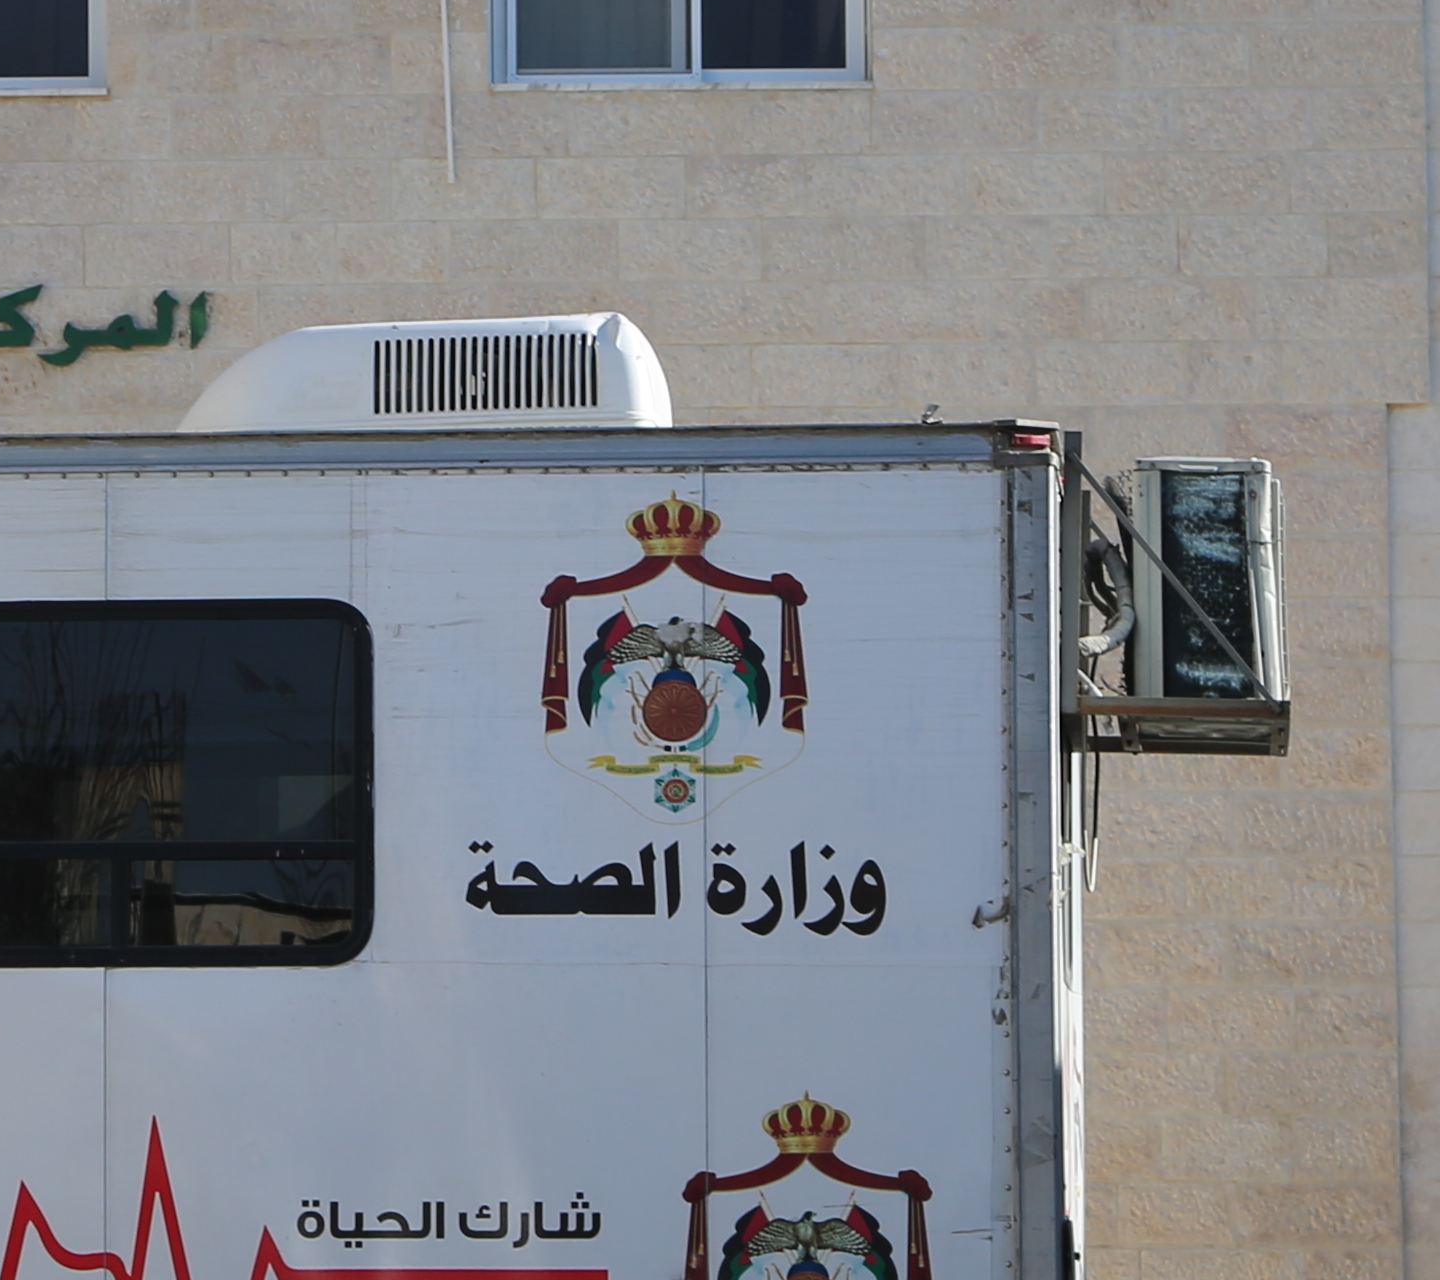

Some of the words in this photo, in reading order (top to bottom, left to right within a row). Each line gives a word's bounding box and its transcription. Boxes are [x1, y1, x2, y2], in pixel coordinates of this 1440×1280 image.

[465, 840, 681, 920] الصحة
[705, 840, 887, 936] وزارة
[297, 1199, 445, 1249] الحياة
[458, 1191, 601, 1249] شارك
